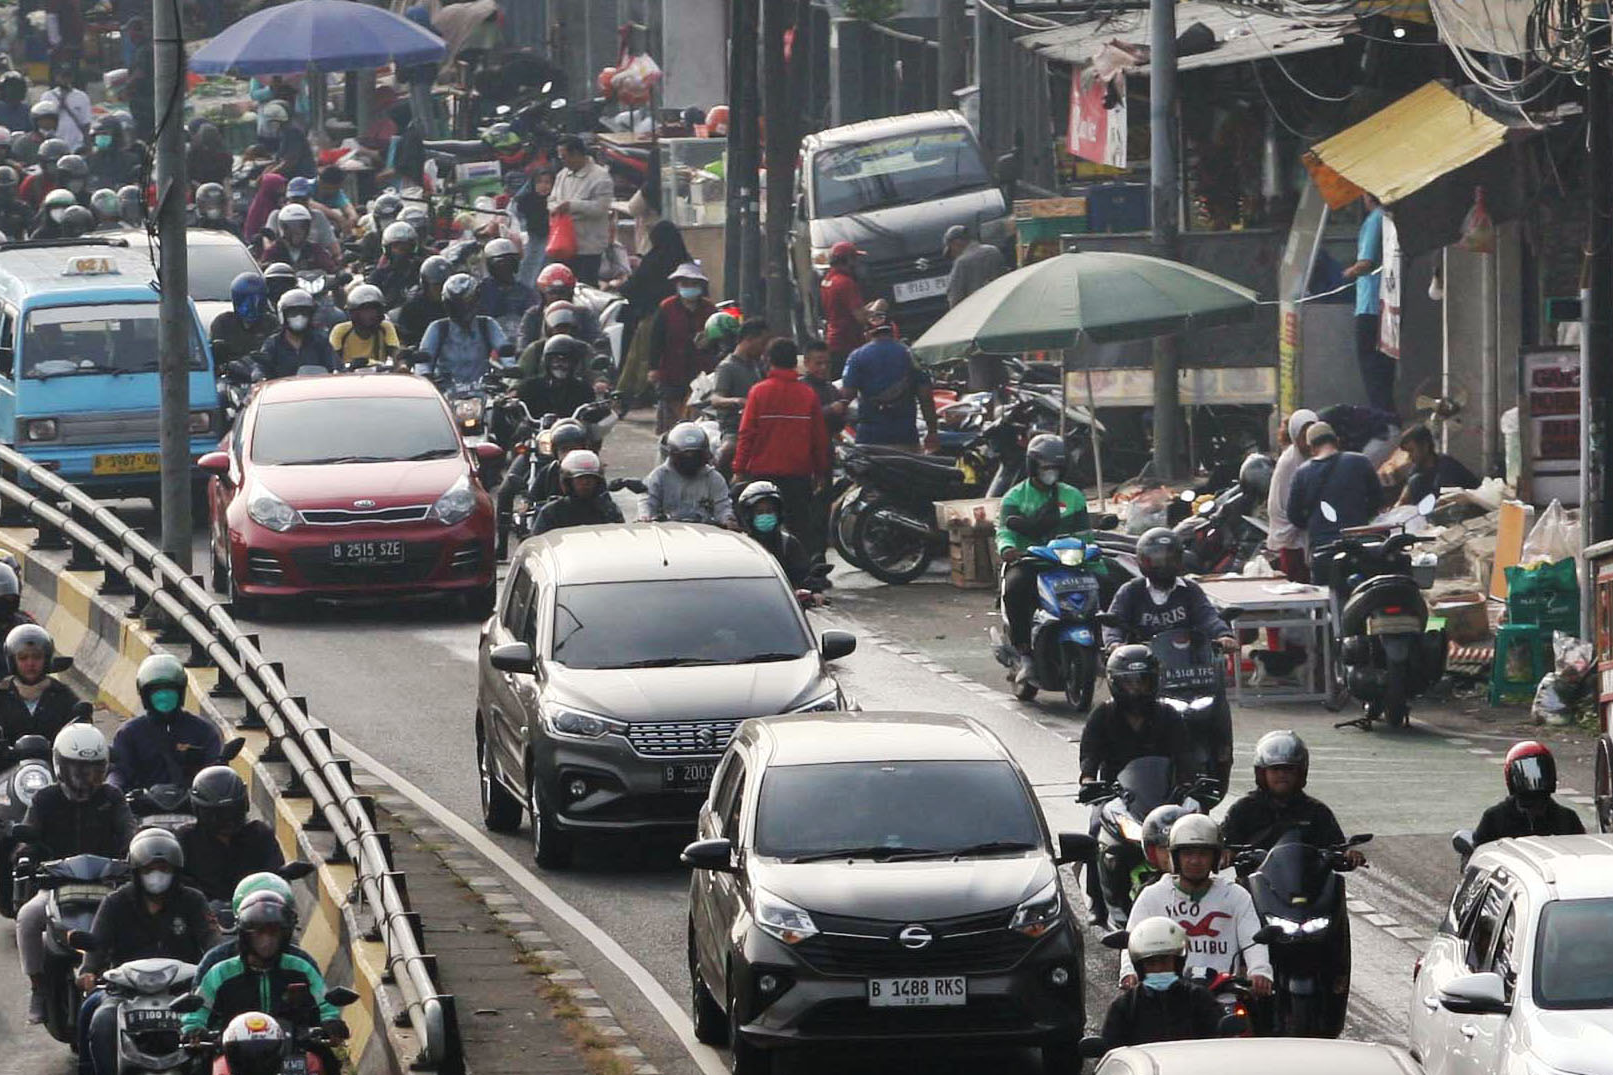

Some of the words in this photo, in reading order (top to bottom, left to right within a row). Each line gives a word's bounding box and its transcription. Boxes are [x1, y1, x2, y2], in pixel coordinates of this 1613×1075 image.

[333, 544, 341, 557] B
[347, 543, 374, 557] 2515
[380, 541, 400, 556] SZE
[1141, 606, 1186, 626] PARIS
[667, 767, 674, 781] B
[872, 981, 881, 996] B
[892, 979, 929, 996] 1488
[935, 978, 964, 995] RKS
